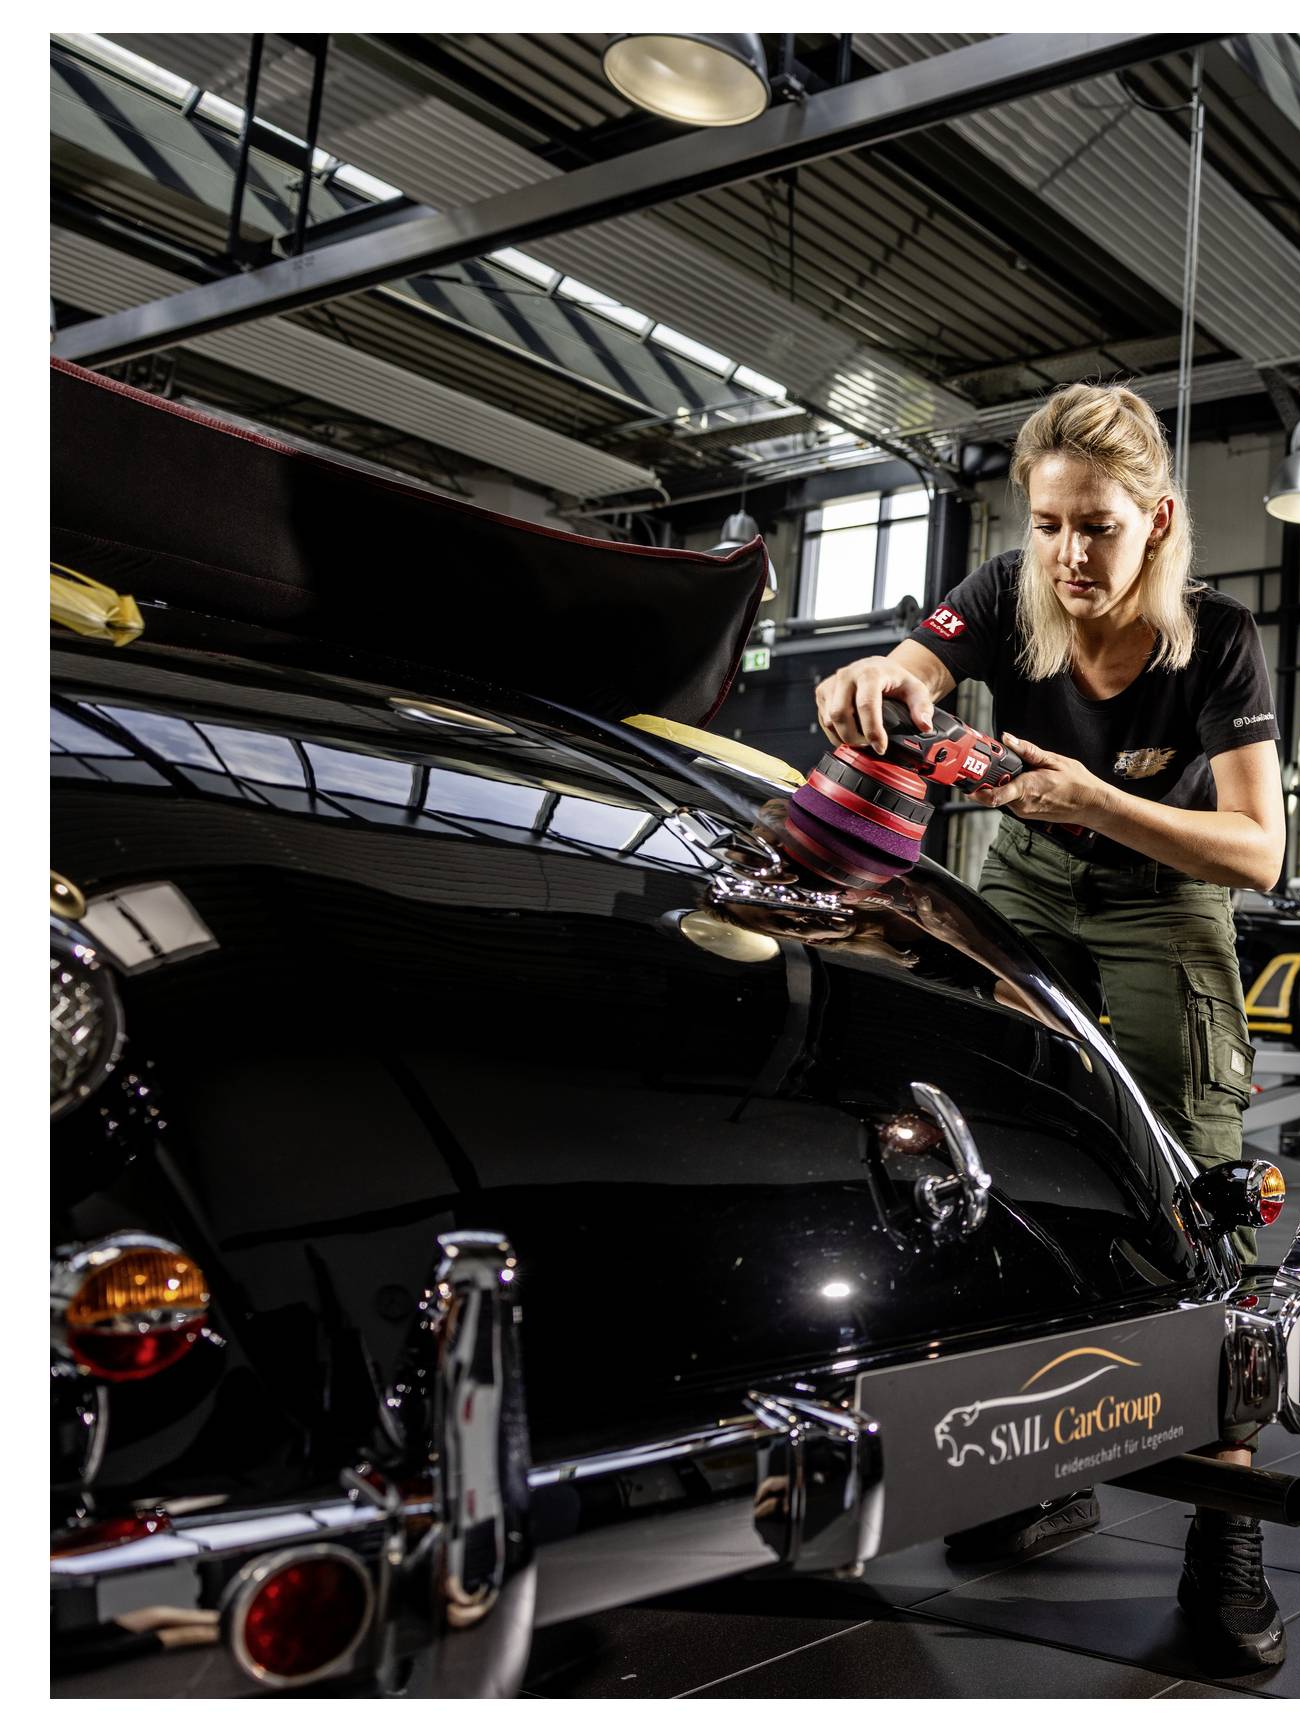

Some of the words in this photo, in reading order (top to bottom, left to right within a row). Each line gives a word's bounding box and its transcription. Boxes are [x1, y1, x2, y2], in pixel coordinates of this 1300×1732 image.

[930, 608, 965, 634] LEX
[962, 755, 988, 777] FLEX
[988, 1414, 1050, 1466] SML
[1054, 1391, 1161, 1445] CarGroup
[1054, 1445, 1121, 1479] Leidenschaft
[1124, 1440, 1139, 1457] für
[1141, 1425, 1184, 1451] Legenden
